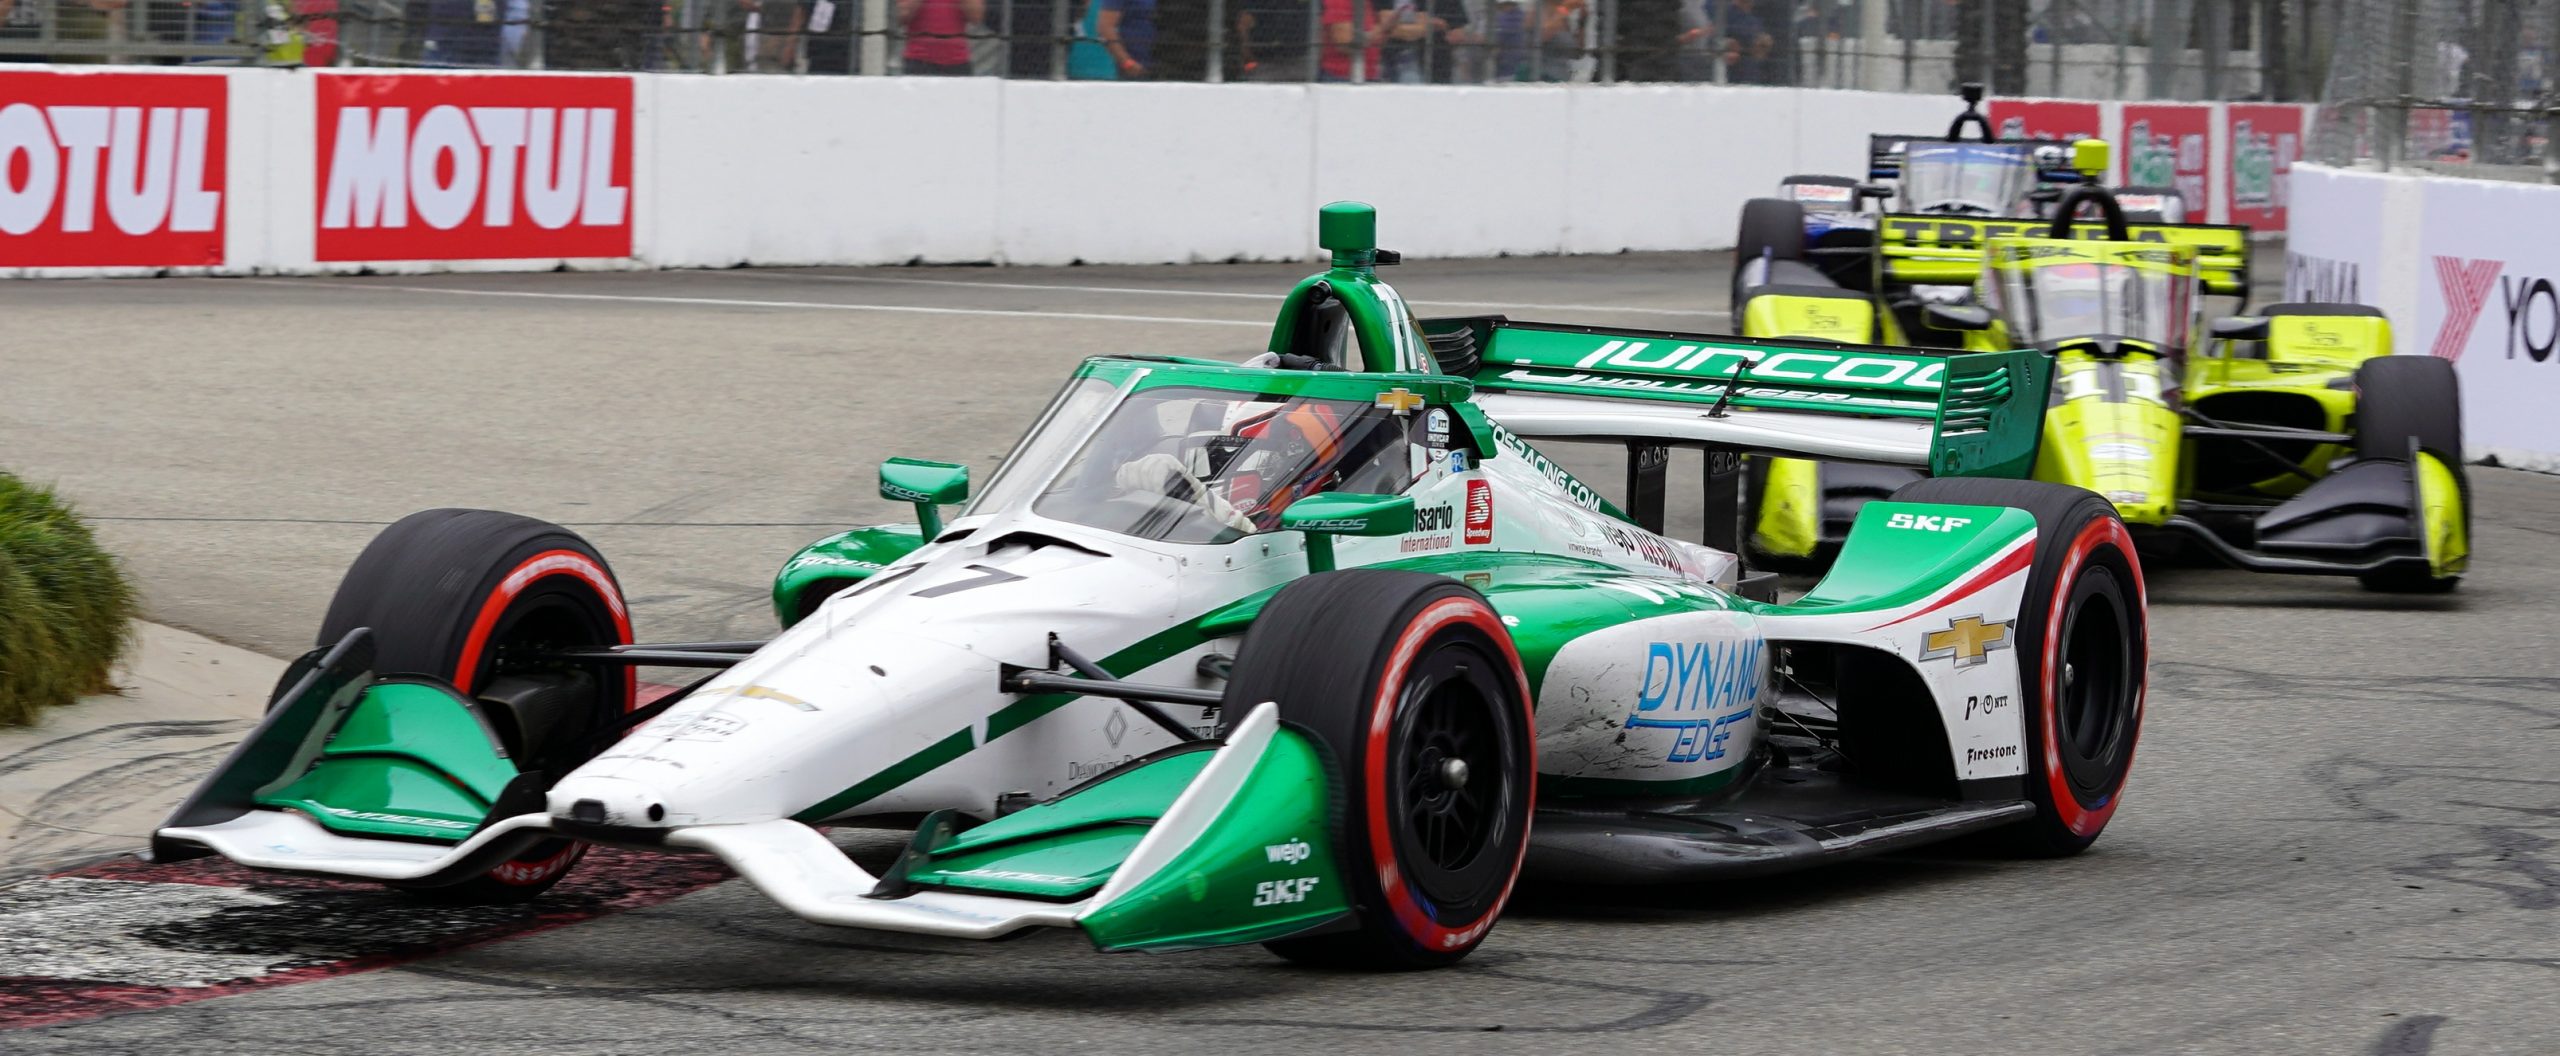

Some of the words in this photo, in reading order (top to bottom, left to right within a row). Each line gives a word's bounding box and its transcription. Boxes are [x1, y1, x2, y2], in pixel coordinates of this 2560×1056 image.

[321, 104, 628, 229] MOTUL
[1411, 500, 1453, 533] nsario
[1886, 512, 1972, 533] SKF
[1400, 532, 1453, 553] International
[1466, 528, 1491, 539] Speedway
[1666, 717, 1730, 763] EDGE
[1967, 744, 2017, 765] Firestone
[1265, 837, 1311, 865] wejo
[1252, 876, 1321, 907] SKF
